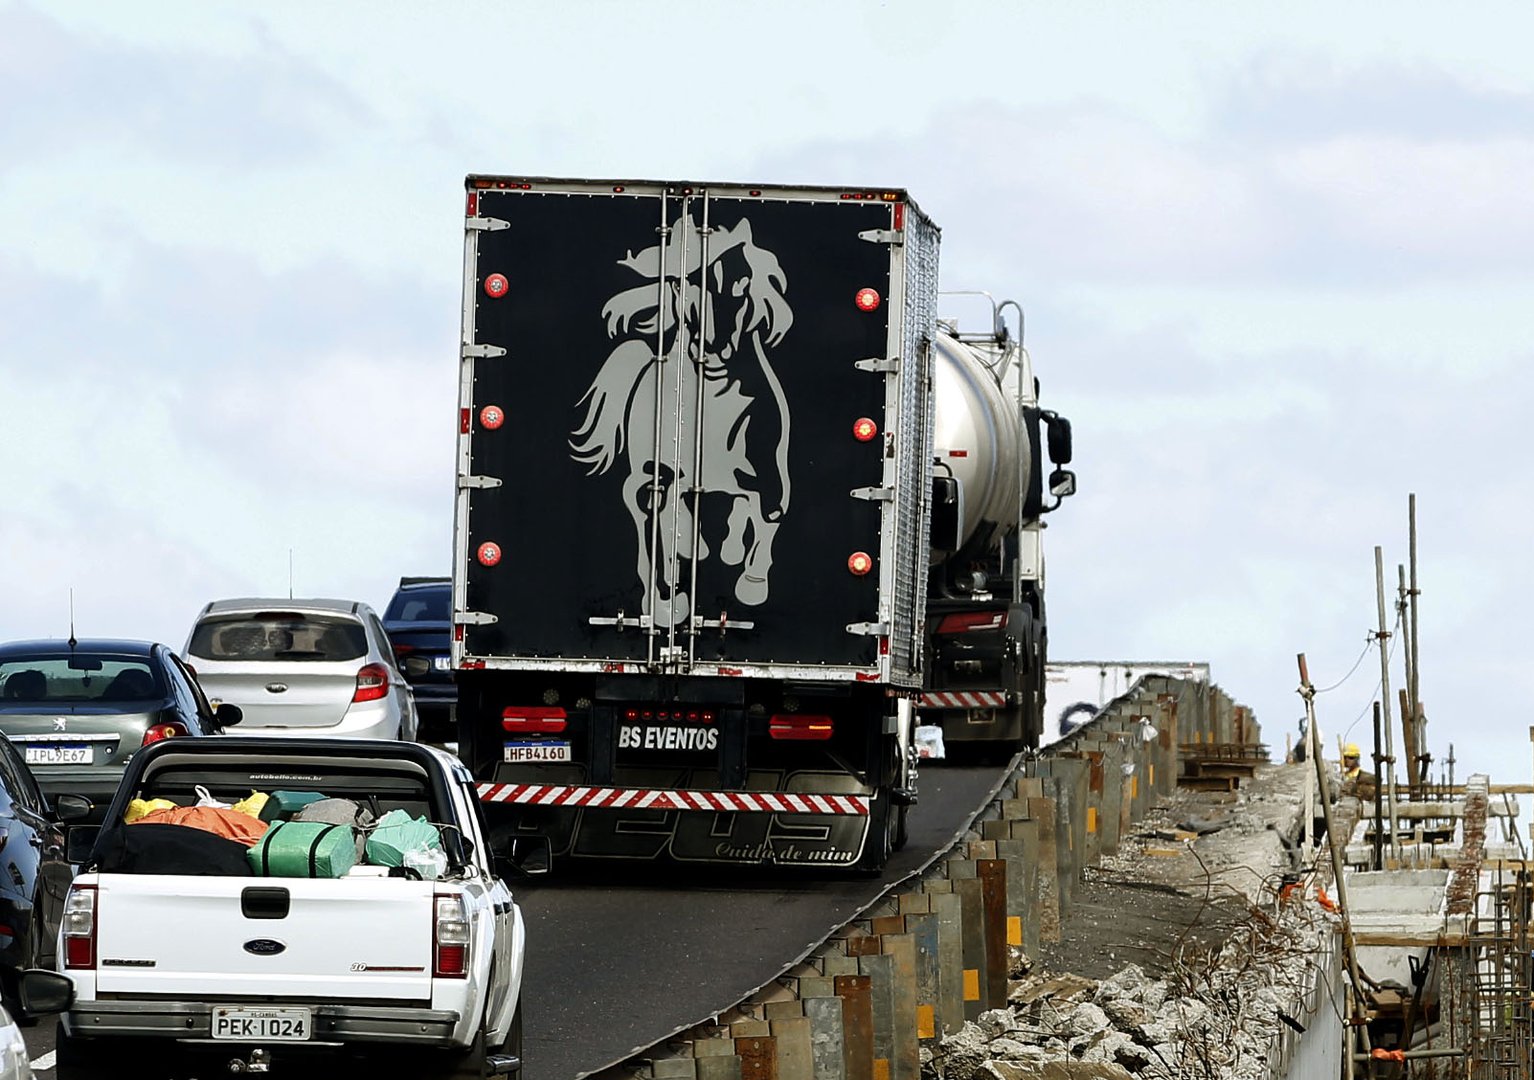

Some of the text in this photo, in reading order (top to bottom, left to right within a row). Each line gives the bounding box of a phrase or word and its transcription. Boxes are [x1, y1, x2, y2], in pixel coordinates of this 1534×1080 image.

[618, 726, 719, 750] BS EVENTOS
[780, 845, 802, 860] de
[808, 846, 853, 861] mim
